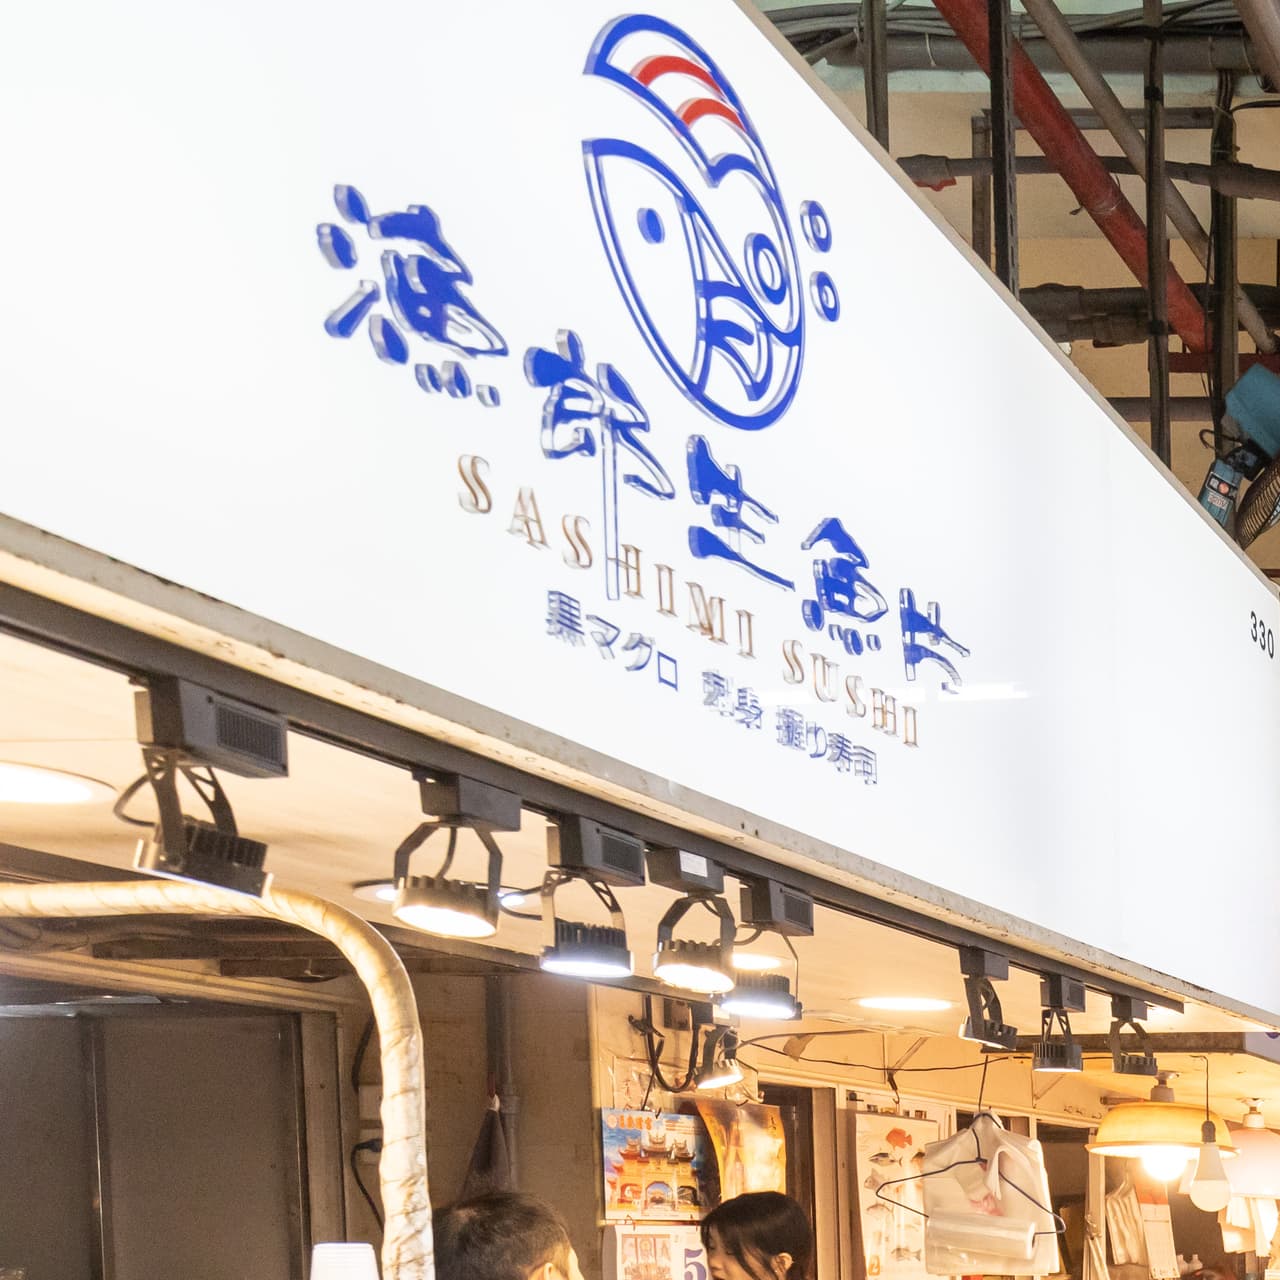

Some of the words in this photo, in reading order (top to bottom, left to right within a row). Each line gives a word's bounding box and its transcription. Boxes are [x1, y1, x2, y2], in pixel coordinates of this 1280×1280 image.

[317, 184, 970, 694] 漁郎生魚片
[459, 455, 756, 659] SASHIMI
[783, 640, 921, 748] SUSHI
[546, 590, 678, 691] 黒マグロ
[1250, 611, 1275, 659] 330
